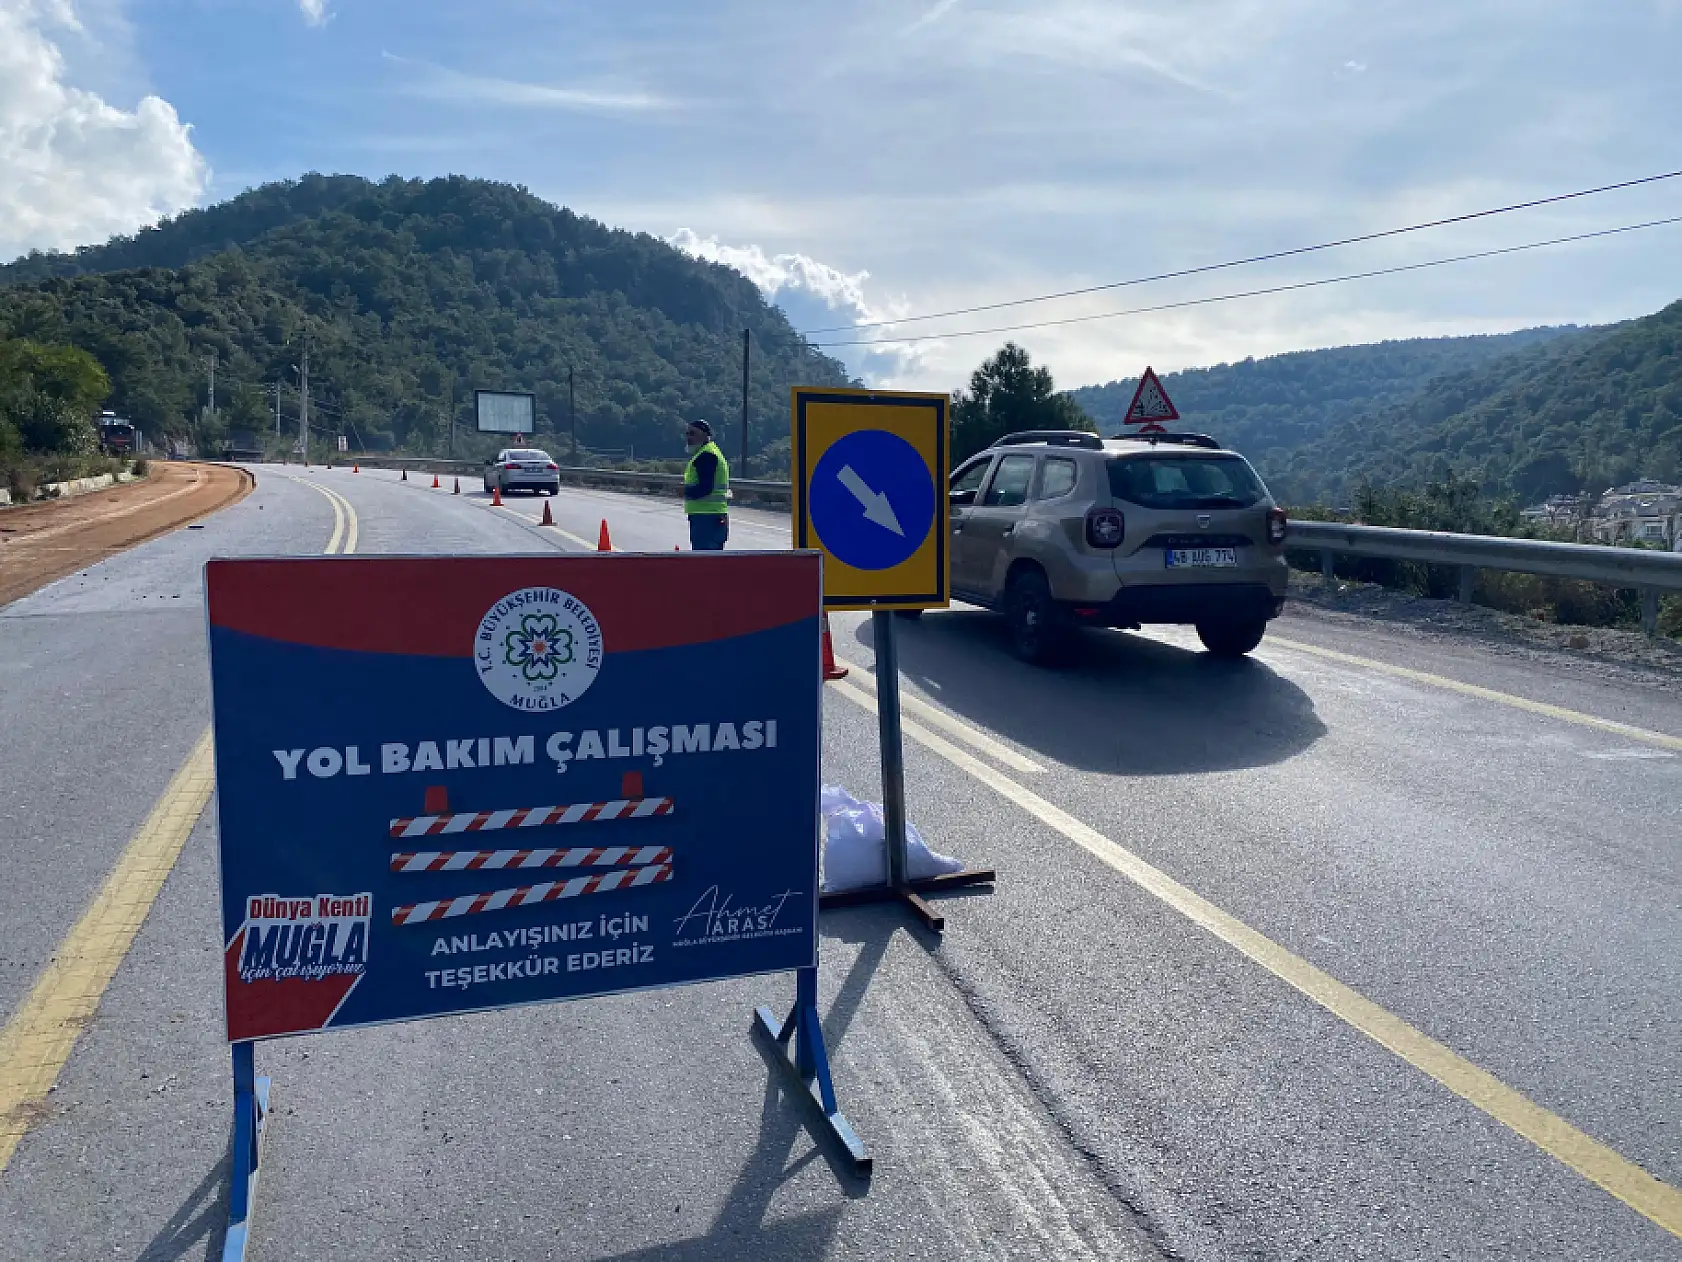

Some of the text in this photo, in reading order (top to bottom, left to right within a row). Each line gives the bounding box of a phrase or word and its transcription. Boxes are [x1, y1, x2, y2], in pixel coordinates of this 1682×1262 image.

[510, 692, 570, 709] MUĞLA
[272, 719, 778, 780] YOL BAKIM ÇALIŞMASI
[250, 895, 369, 921] Dünya Kenti
[673, 884, 803, 936] Ahmet
[712, 916, 768, 936] ARAS
[243, 920, 366, 968] MUĞLA
[431, 921, 594, 956] ANLAYIŞINIZ
[600, 912, 649, 940] İÇİN
[424, 941, 654, 991] TEŞEKKÜR EDERİZ
